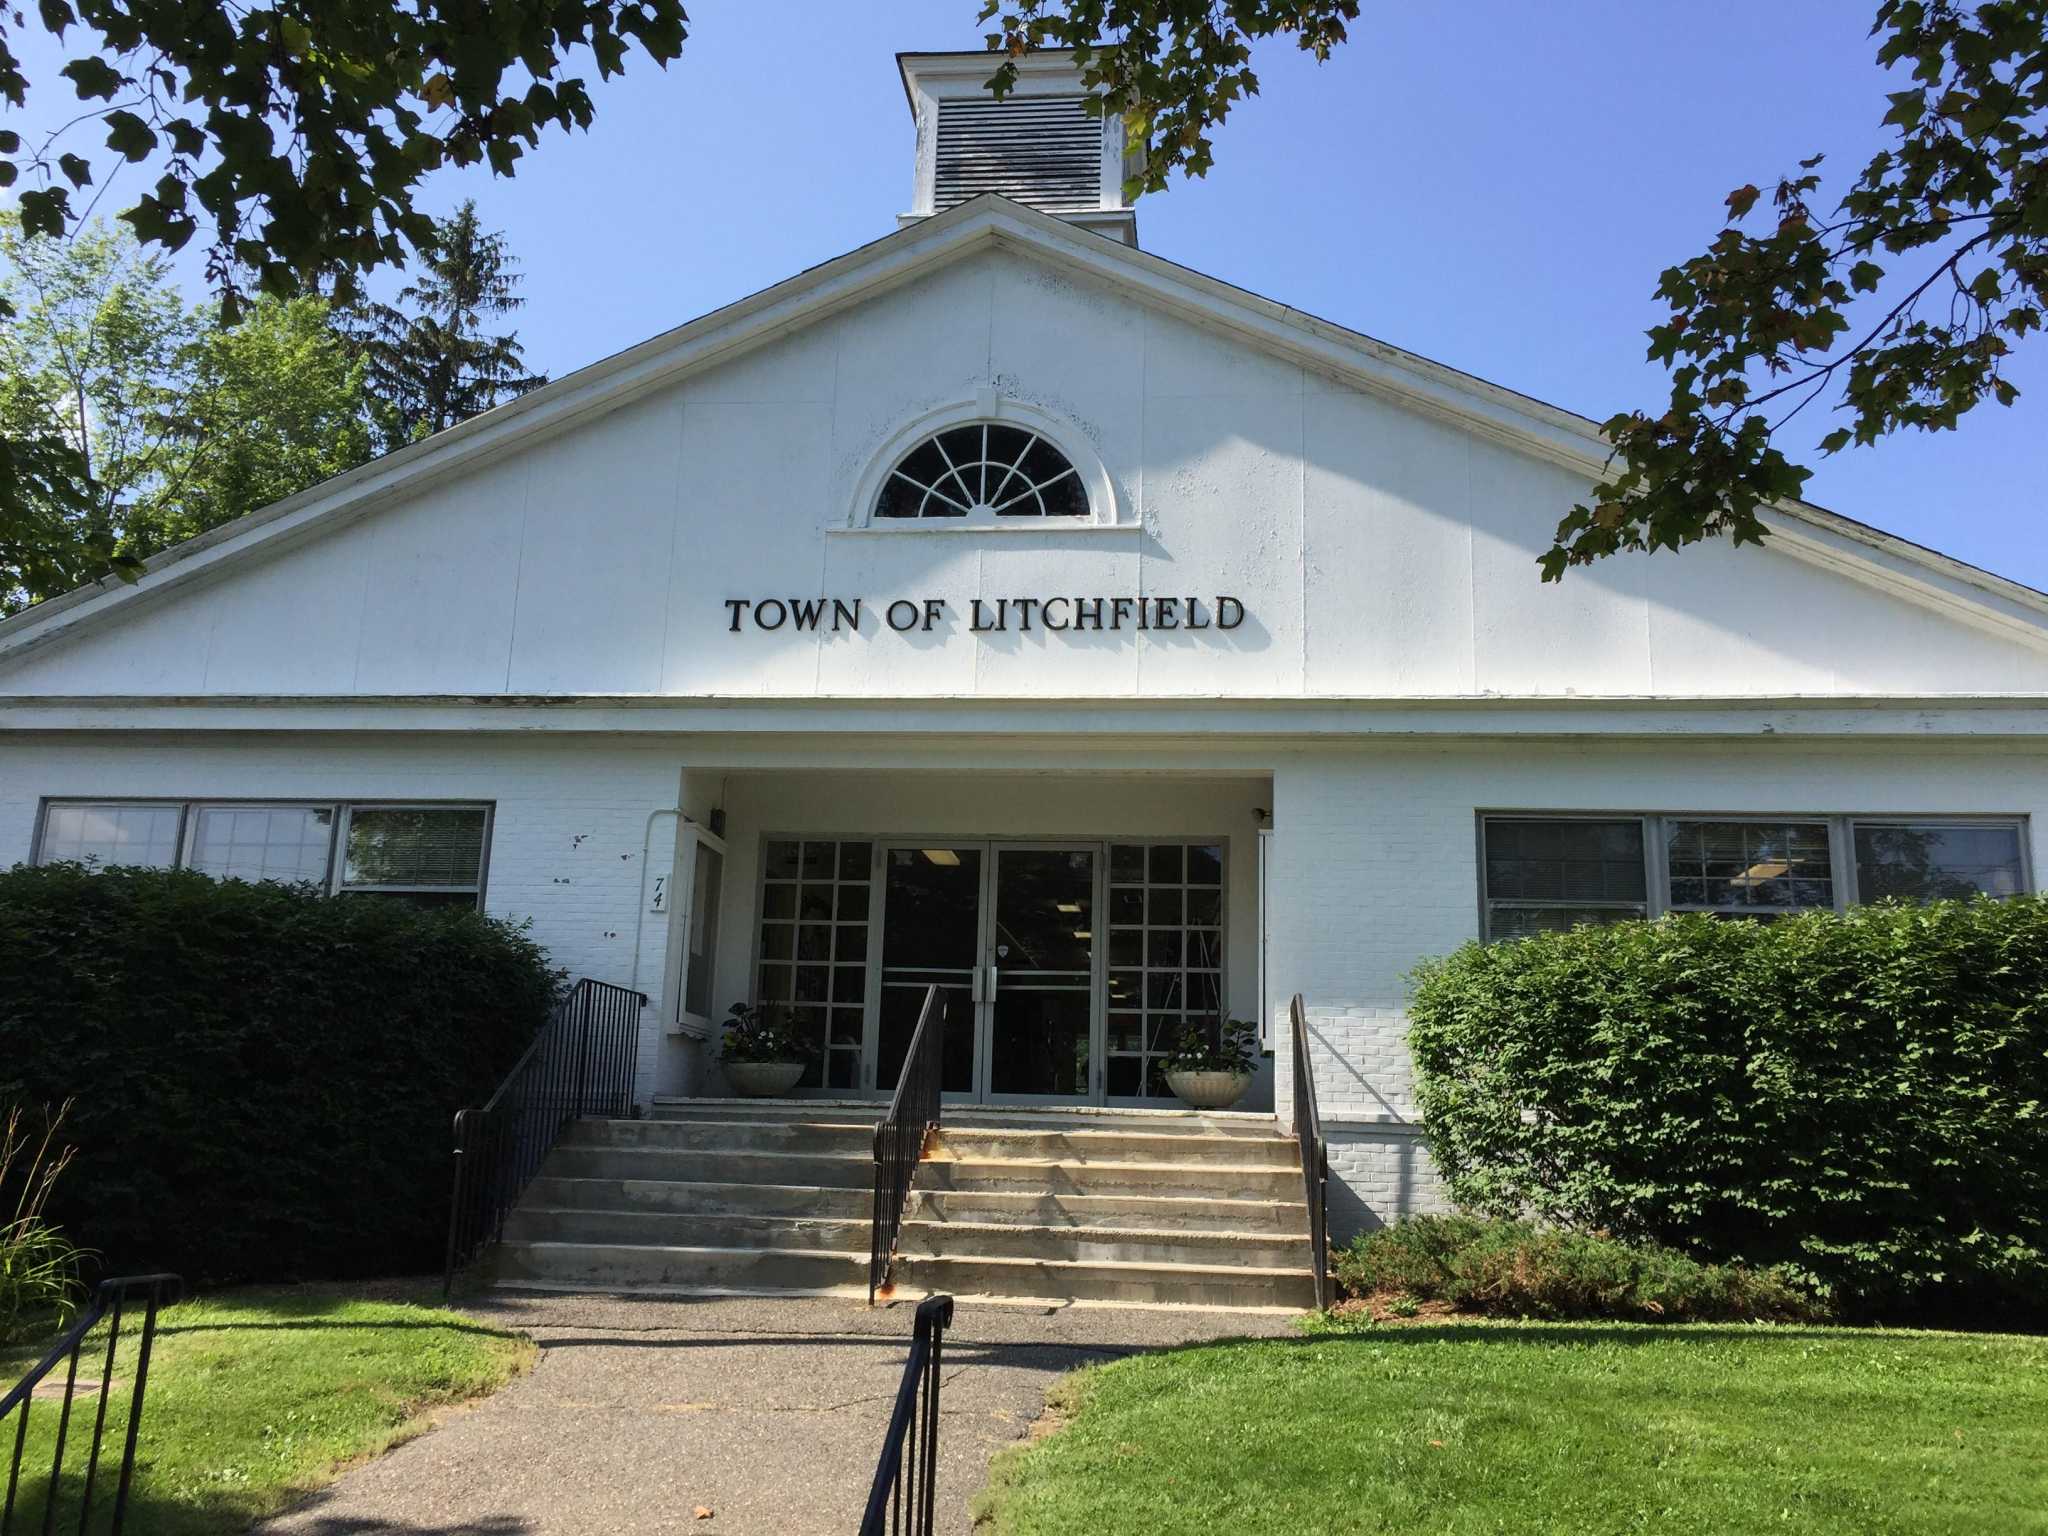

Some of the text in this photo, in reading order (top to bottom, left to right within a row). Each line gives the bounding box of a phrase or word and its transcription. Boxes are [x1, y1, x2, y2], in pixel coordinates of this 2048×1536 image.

[725, 596, 1244, 632] TOWN OF LITCHFIELD
